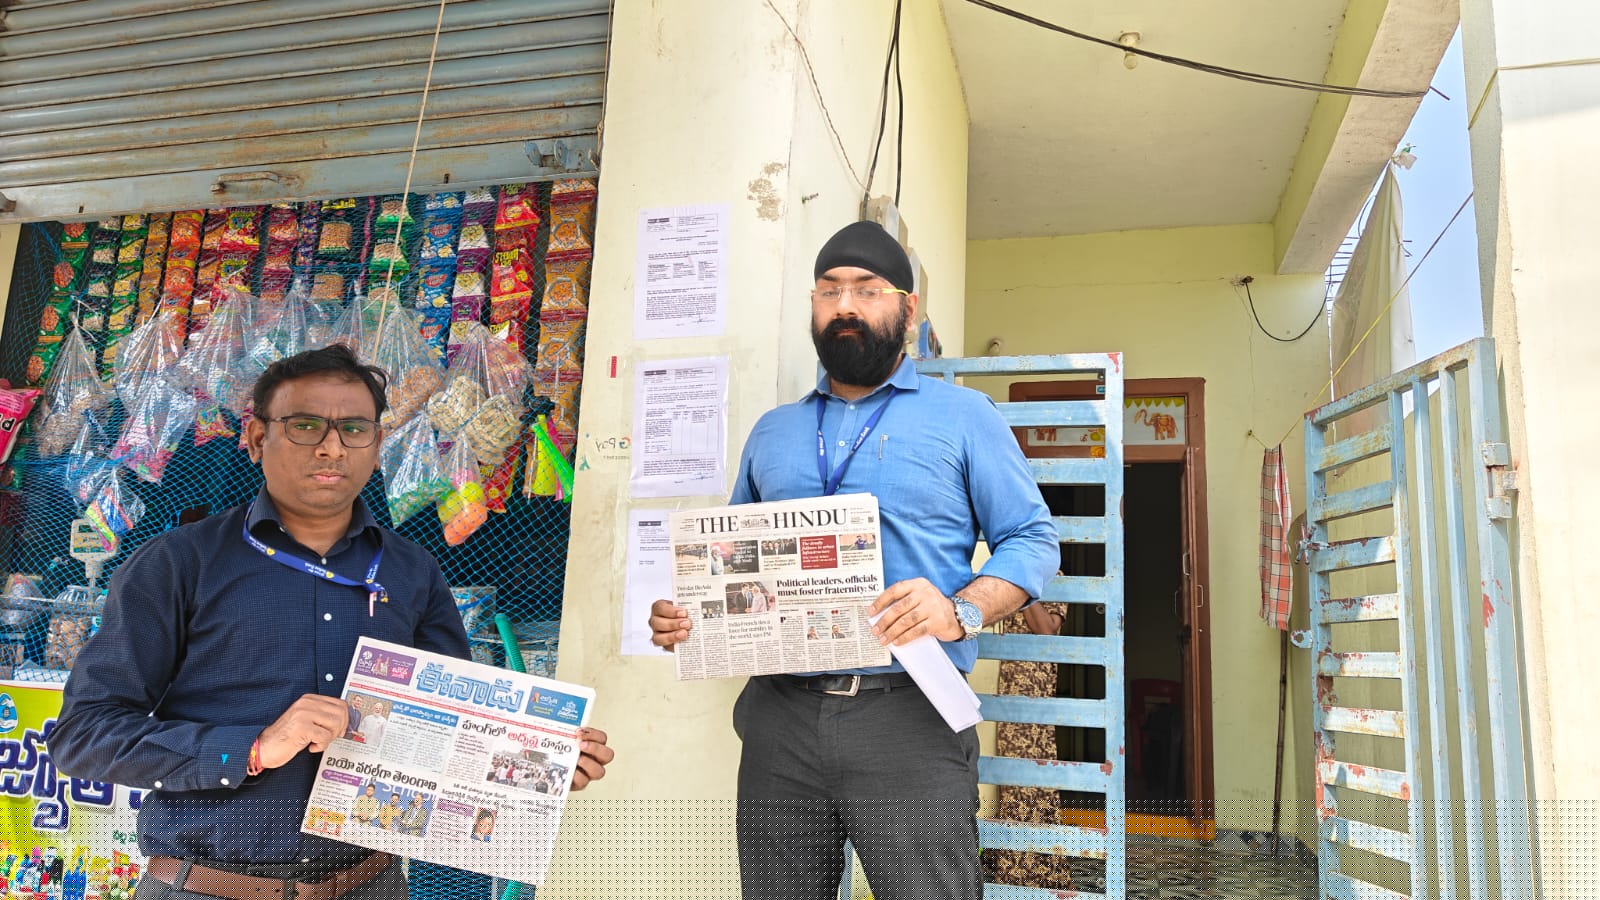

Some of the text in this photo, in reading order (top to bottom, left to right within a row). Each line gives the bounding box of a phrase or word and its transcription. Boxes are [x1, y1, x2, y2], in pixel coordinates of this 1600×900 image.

[696, 515, 739, 534] THE
[773, 508, 848, 529] HINDU
[776, 574, 878, 588] Political leaders, officials
[777, 583, 879, 596] must foster fraternity: SC
[415, 661, 526, 713] ఈనాడు
[326, 756, 355, 771] బయో
[392, 770, 438, 791] తెలంగాణ
